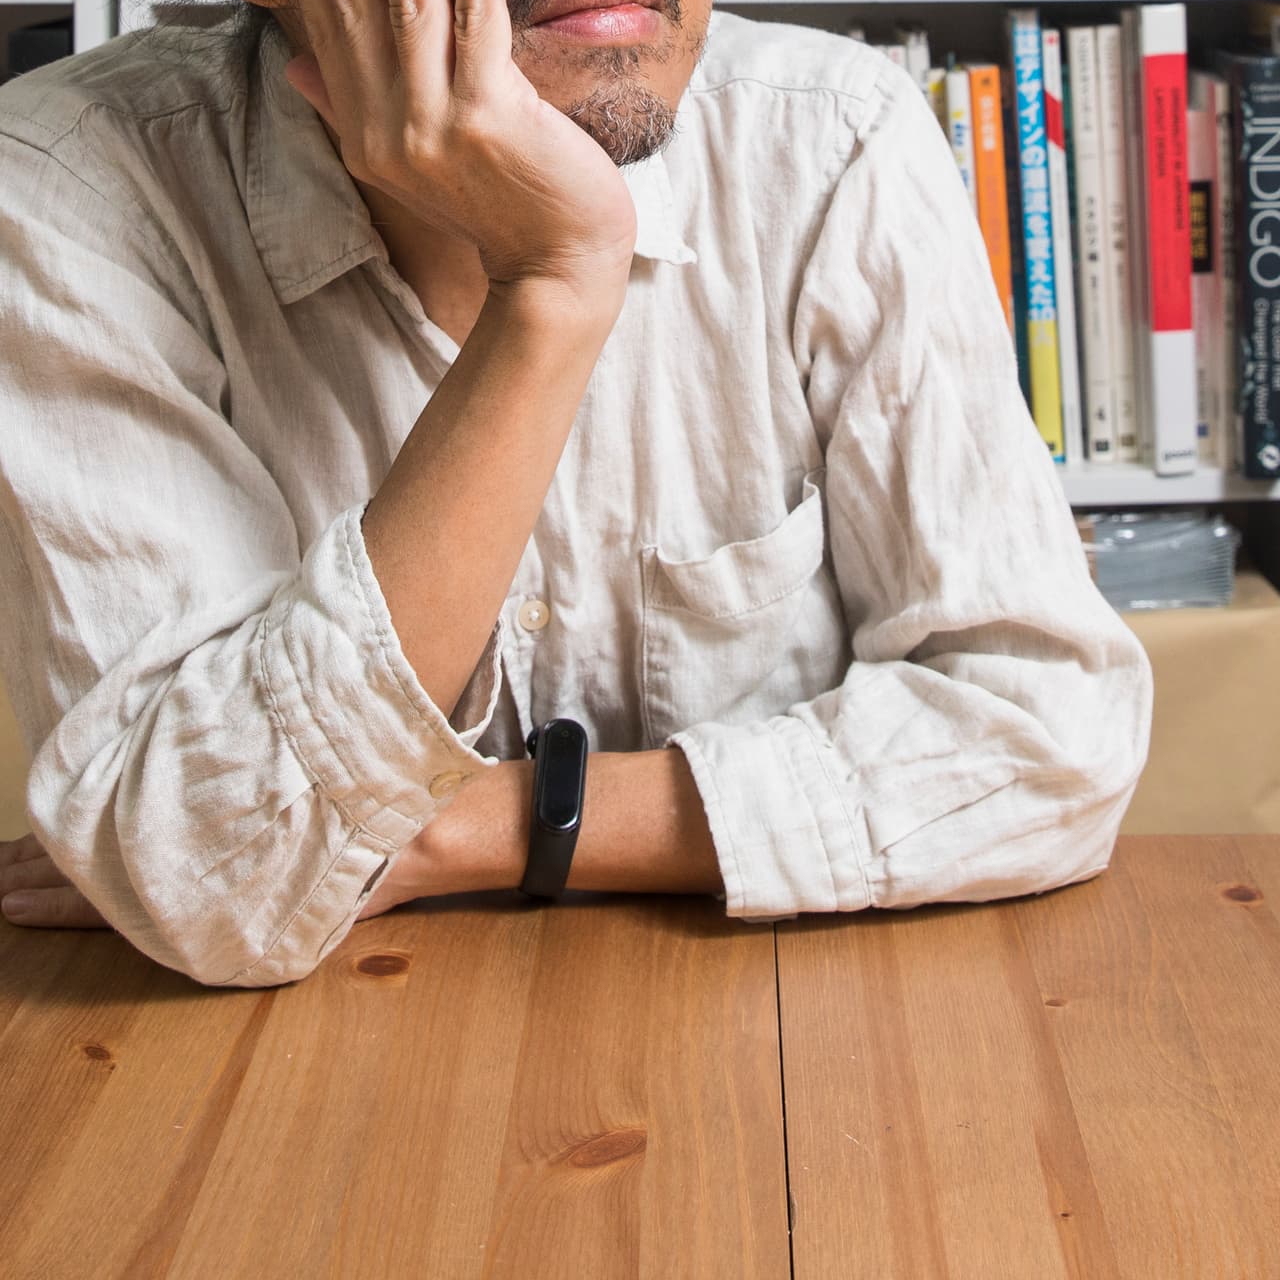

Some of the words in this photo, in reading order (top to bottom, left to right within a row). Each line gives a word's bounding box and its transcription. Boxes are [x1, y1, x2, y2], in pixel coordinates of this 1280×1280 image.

[1251, 297, 1271, 358] Changed
[1253, 361, 1270, 382] the
[1251, 385, 1270, 425] World
